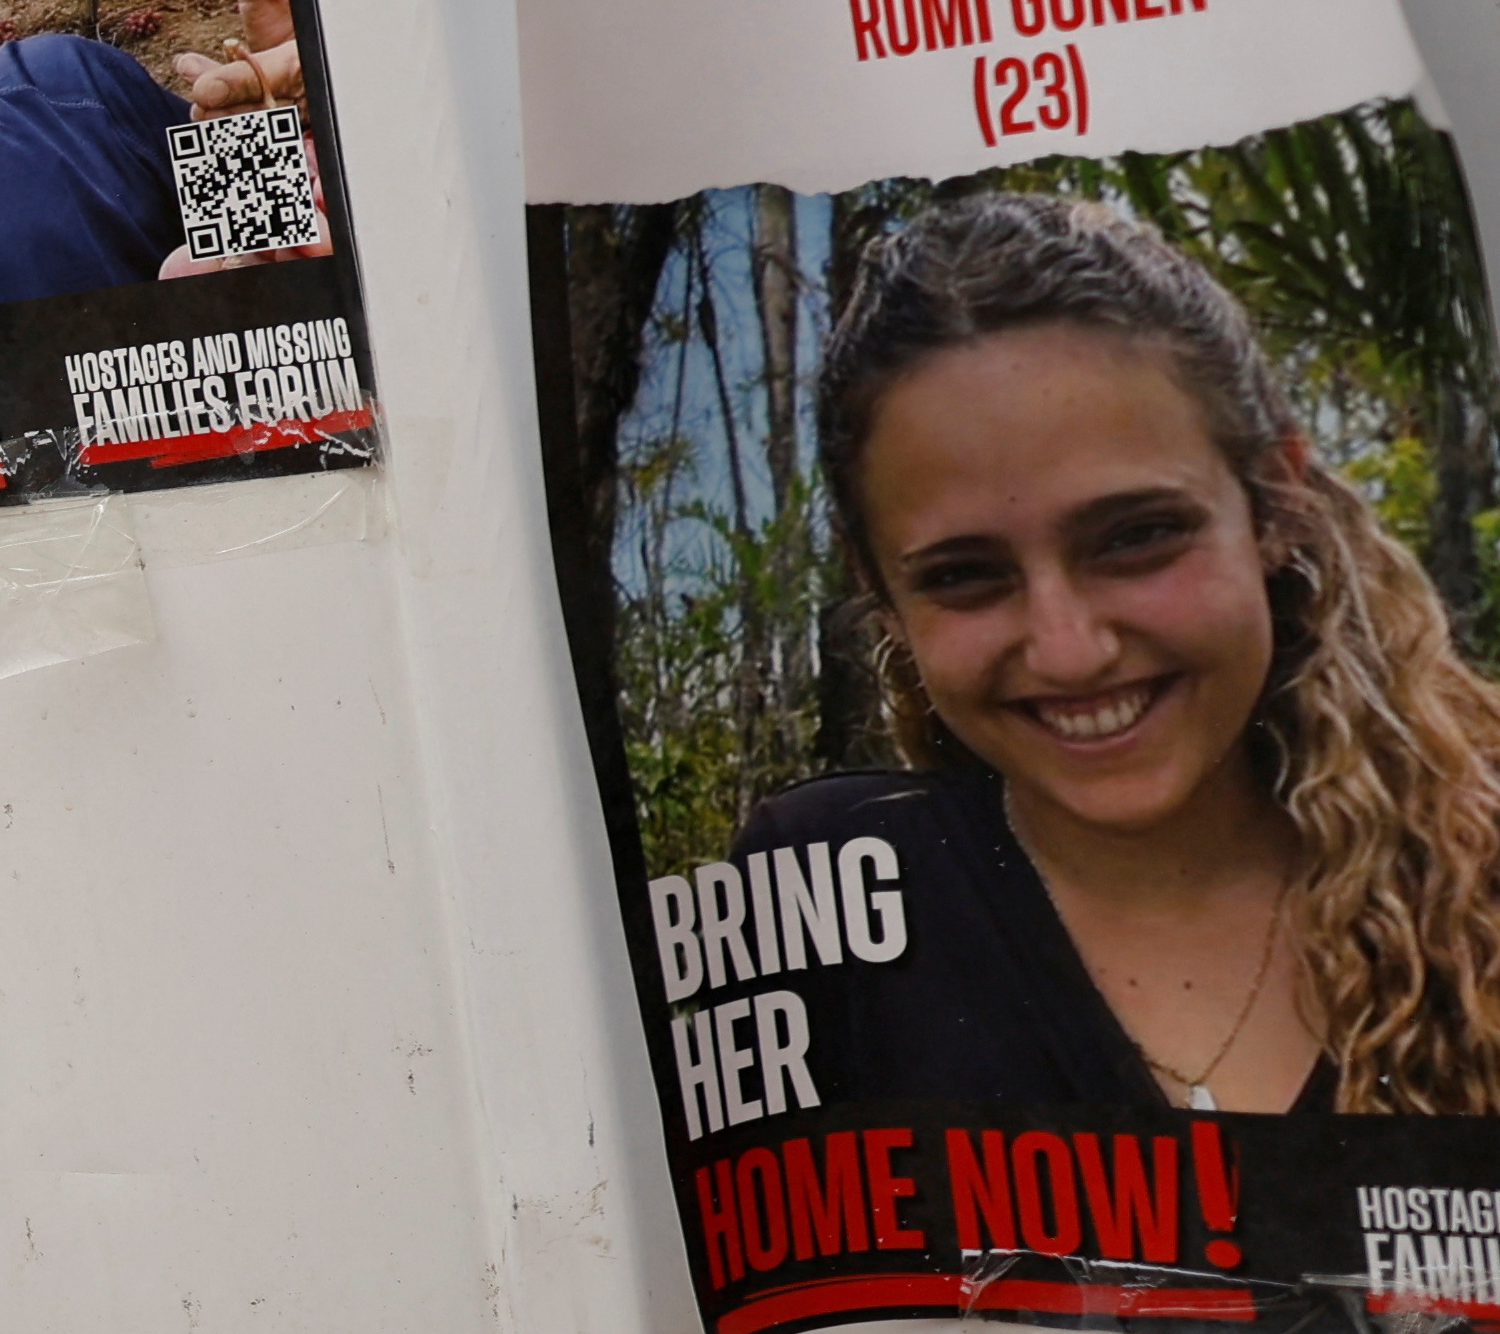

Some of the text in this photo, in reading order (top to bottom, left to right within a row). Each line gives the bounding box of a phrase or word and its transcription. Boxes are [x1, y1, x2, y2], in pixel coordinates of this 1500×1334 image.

[972, 42, 1090, 148] (23)
[64, 317, 353, 394] HOSTAGES AND MISSING
[72, 358, 364, 447] FAMILIES FORUM
[647, 835, 908, 1004] BRING
[671, 989, 823, 1142] HER
[695, 1119, 1244, 1292] HOME NOW!
